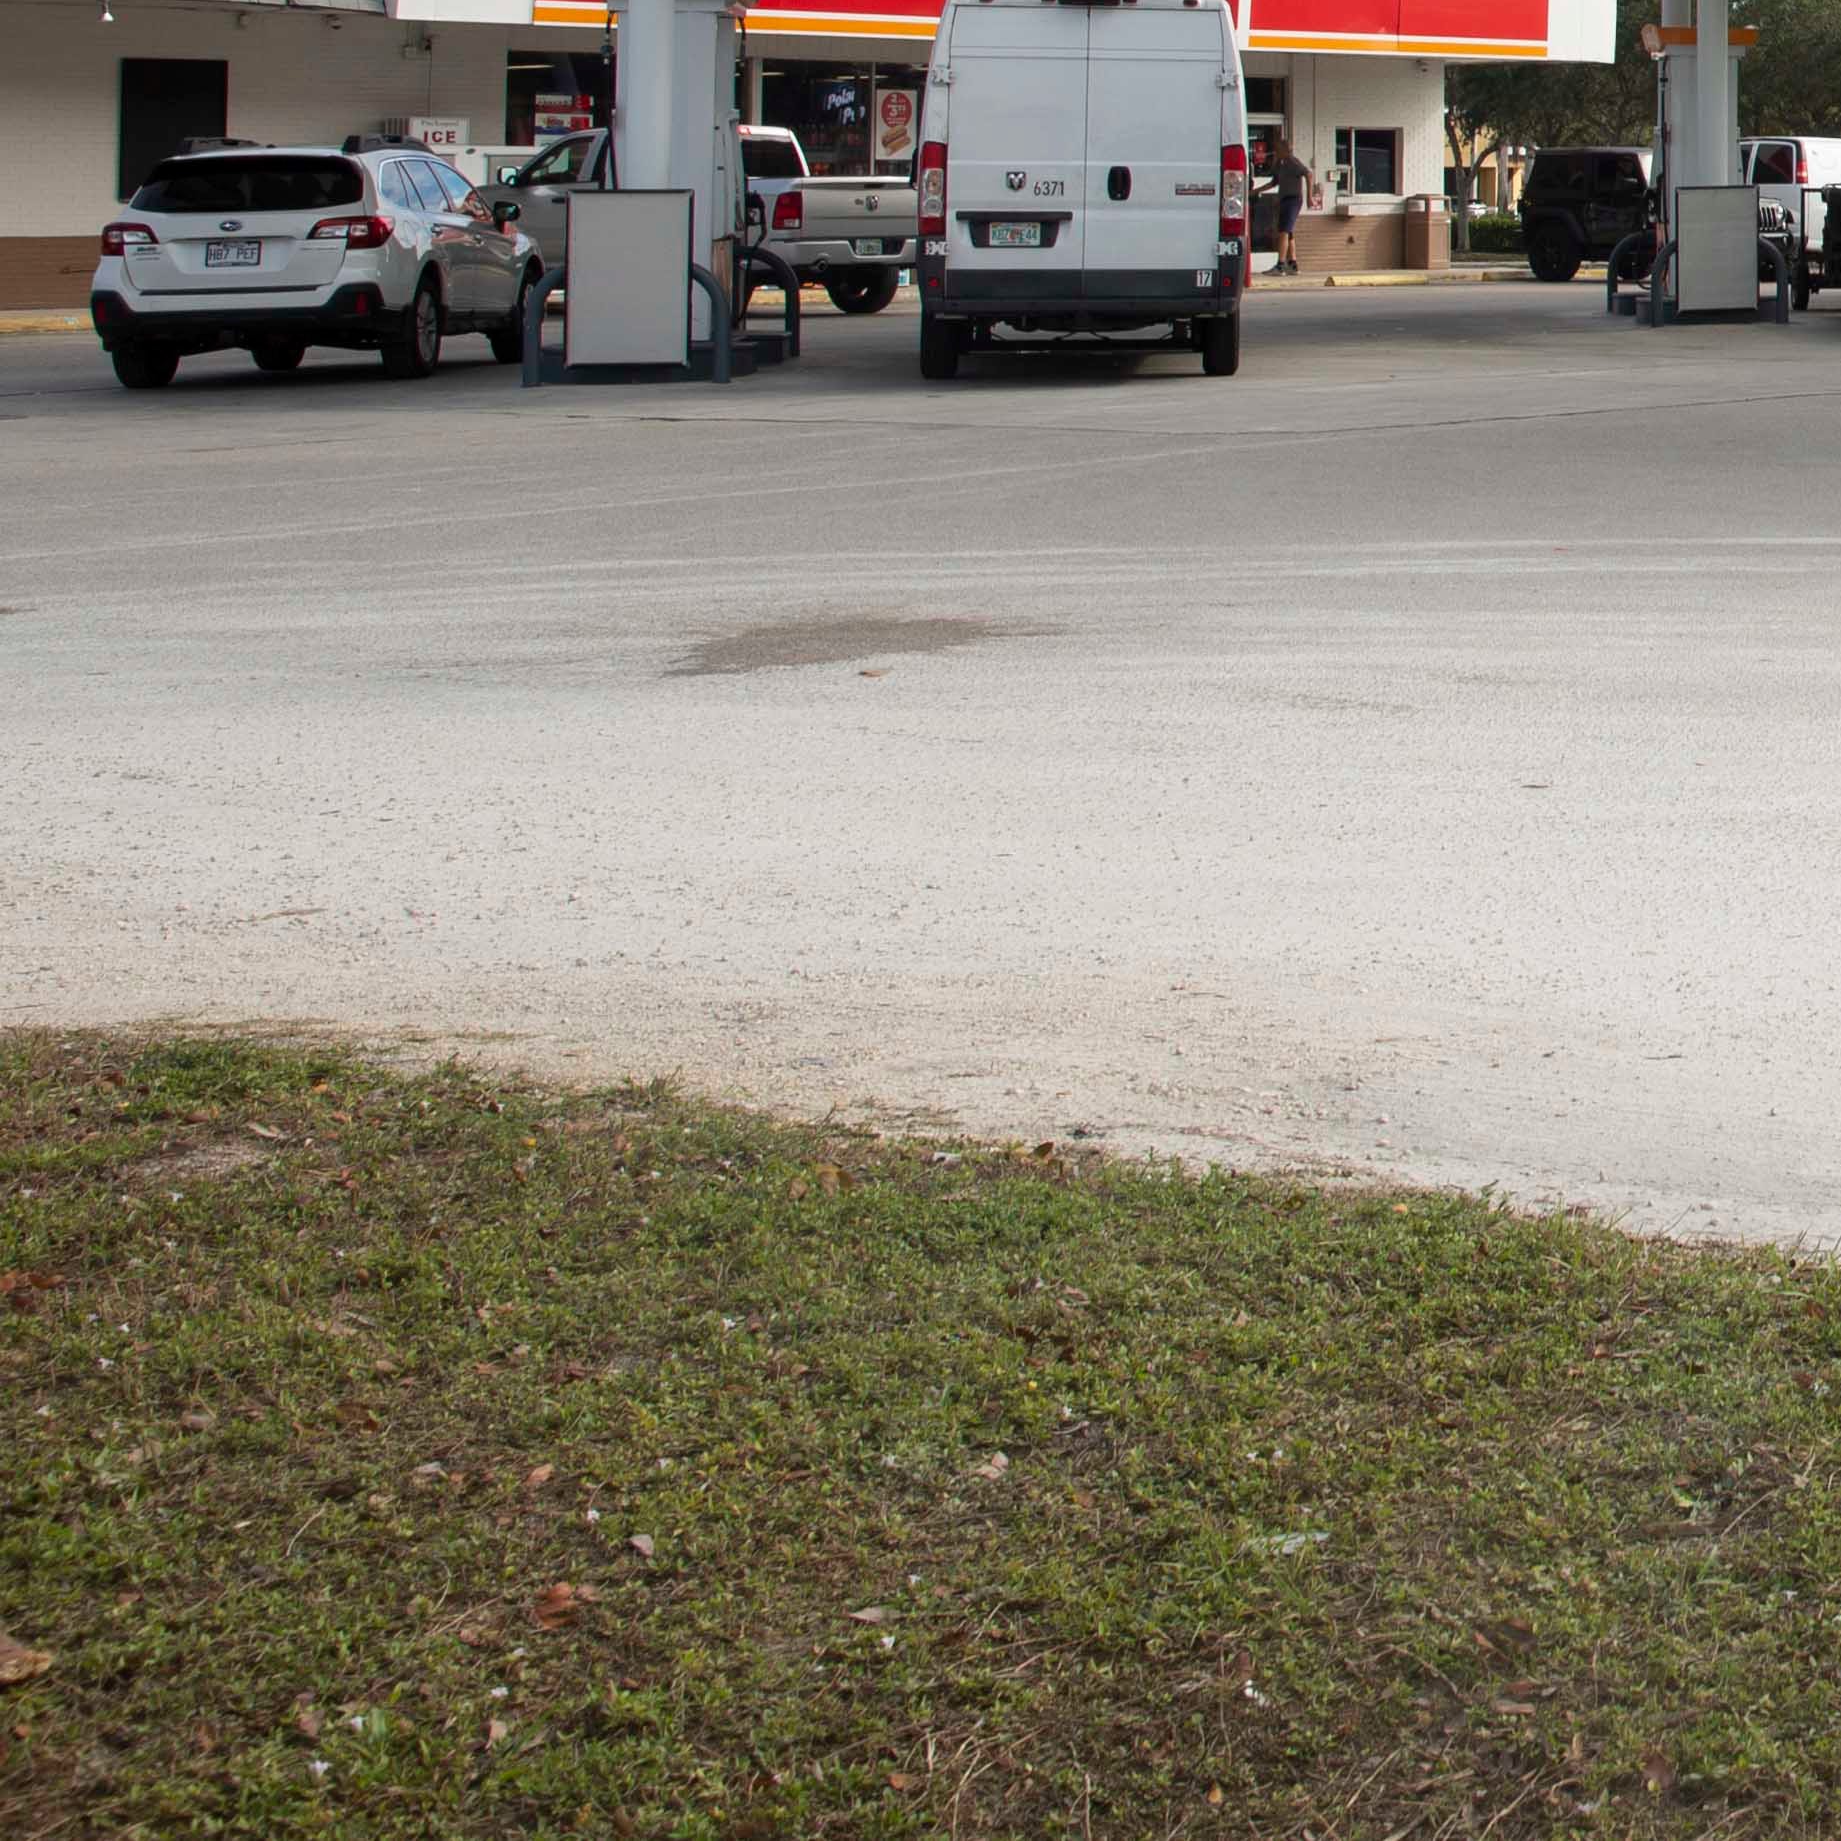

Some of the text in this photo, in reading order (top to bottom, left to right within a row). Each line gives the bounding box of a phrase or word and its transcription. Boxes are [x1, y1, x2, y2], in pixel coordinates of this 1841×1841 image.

[424, 130, 456, 143] ICE
[1033, 181, 1065, 197] 6371
[1197, 270, 1212, 287] 17
